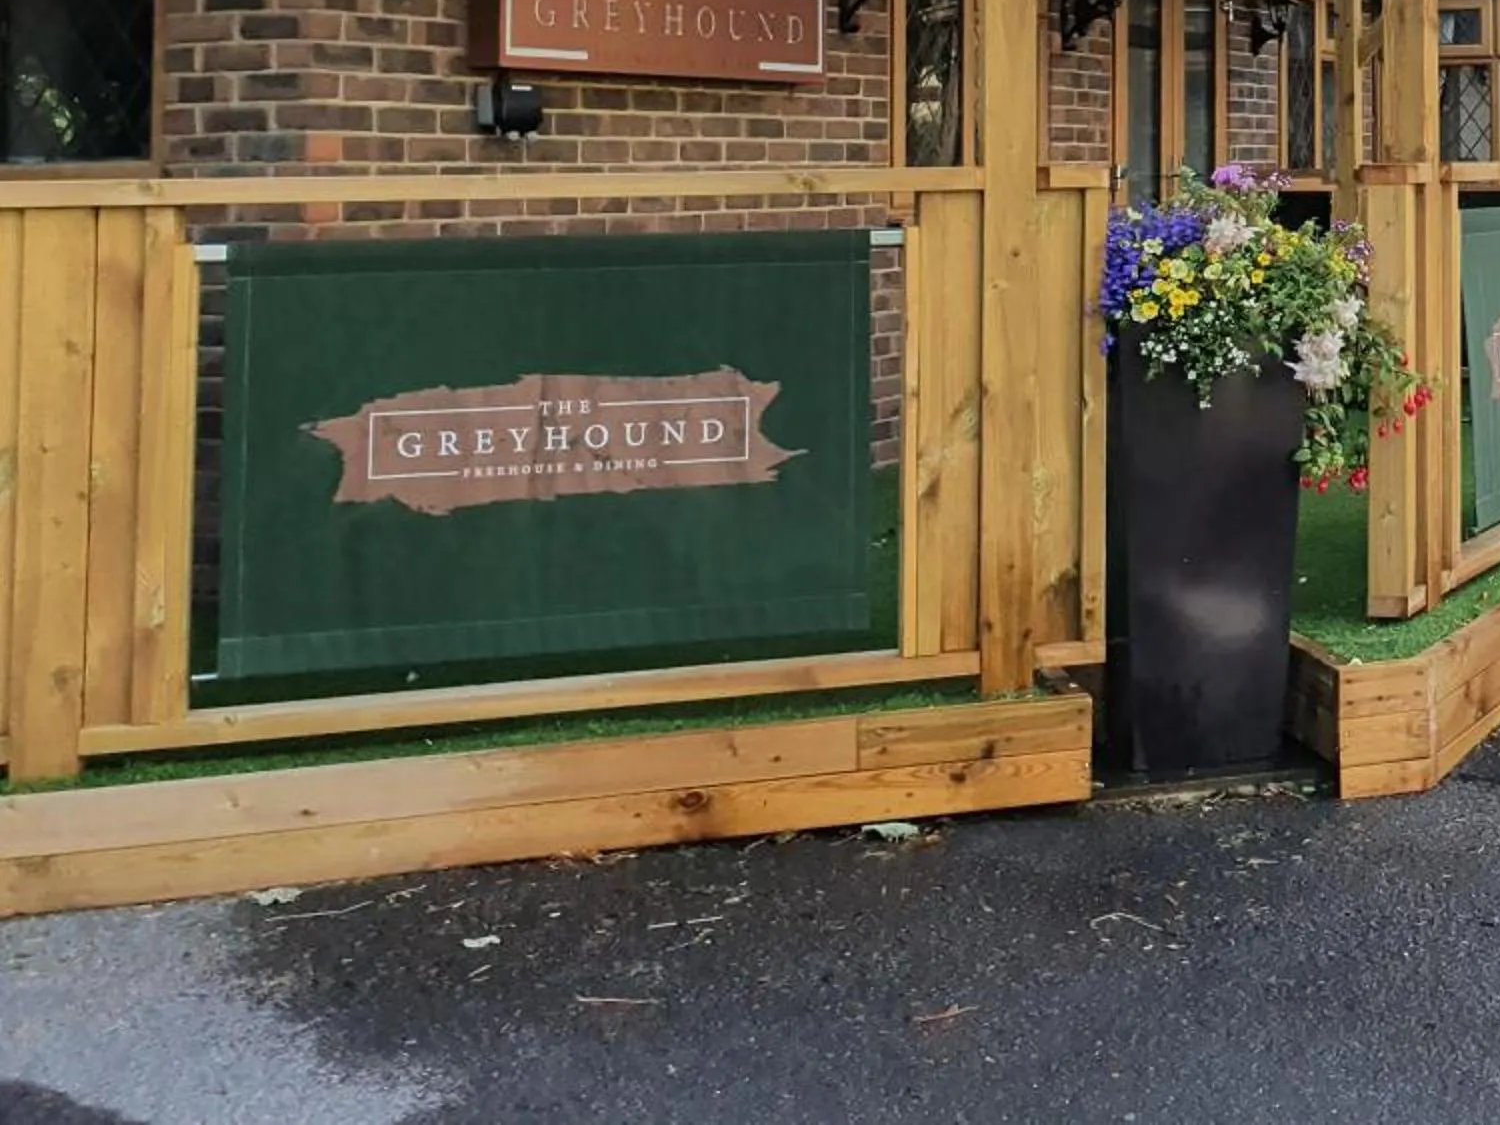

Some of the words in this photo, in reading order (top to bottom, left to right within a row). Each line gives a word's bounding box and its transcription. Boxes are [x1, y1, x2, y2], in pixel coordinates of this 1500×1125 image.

[539, 399, 592, 416] THE
[397, 419, 725, 458] GREYHOUND
[593, 458, 659, 473] DINING
